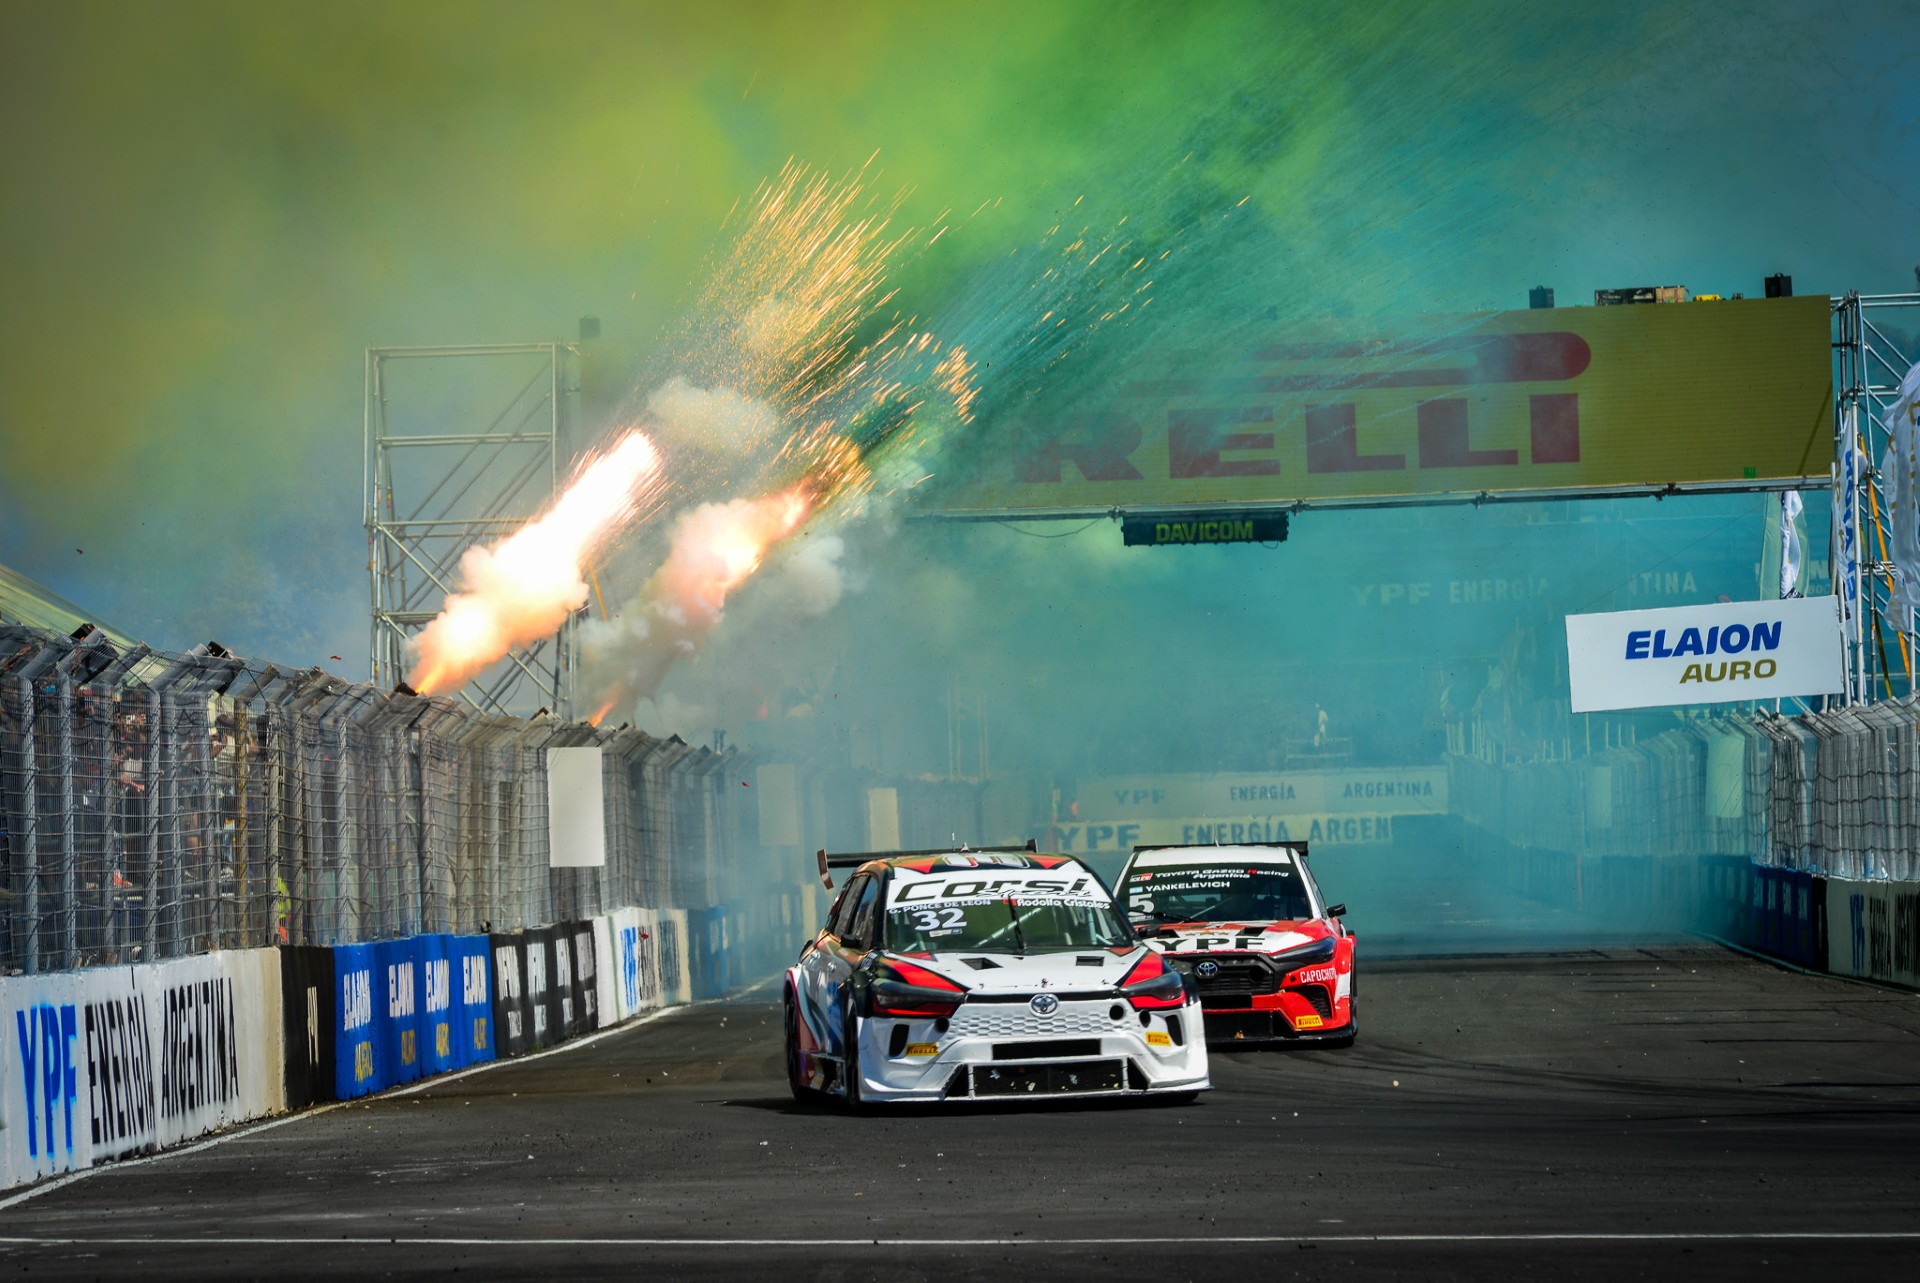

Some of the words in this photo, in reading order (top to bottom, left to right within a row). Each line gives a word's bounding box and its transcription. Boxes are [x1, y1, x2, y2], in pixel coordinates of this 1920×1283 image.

[1014, 332, 1590, 486] RELLI
[1155, 521, 1254, 542] DAVICOM
[1350, 583, 1431, 605] YPF
[1625, 620, 1783, 661] ELAION
[1679, 658, 1778, 684] AURO
[1113, 789, 1166, 806] YPF
[1229, 782, 1297, 801] ENERGÍA
[1342, 780, 1433, 800] ARGENTINA
[1056, 823, 1141, 851] YPF
[1183, 815, 1291, 846] ENERGÍA
[1309, 817, 1391, 845] ARGEN
[1155, 869, 1200, 878] TOYOTA
[1247, 868, 1290, 878] Racing
[1145, 881, 1231, 892] YANKELEVICH
[903, 903, 939, 912] PONCE
[939, 901, 958, 909] DE
[1128, 893, 1155, 916] 5
[911, 908, 968, 931] 32
[1153, 937, 1267, 951] YPF
[16, 1003, 78, 1157] YPF
[160, 976, 240, 1119] ARGENTINA
